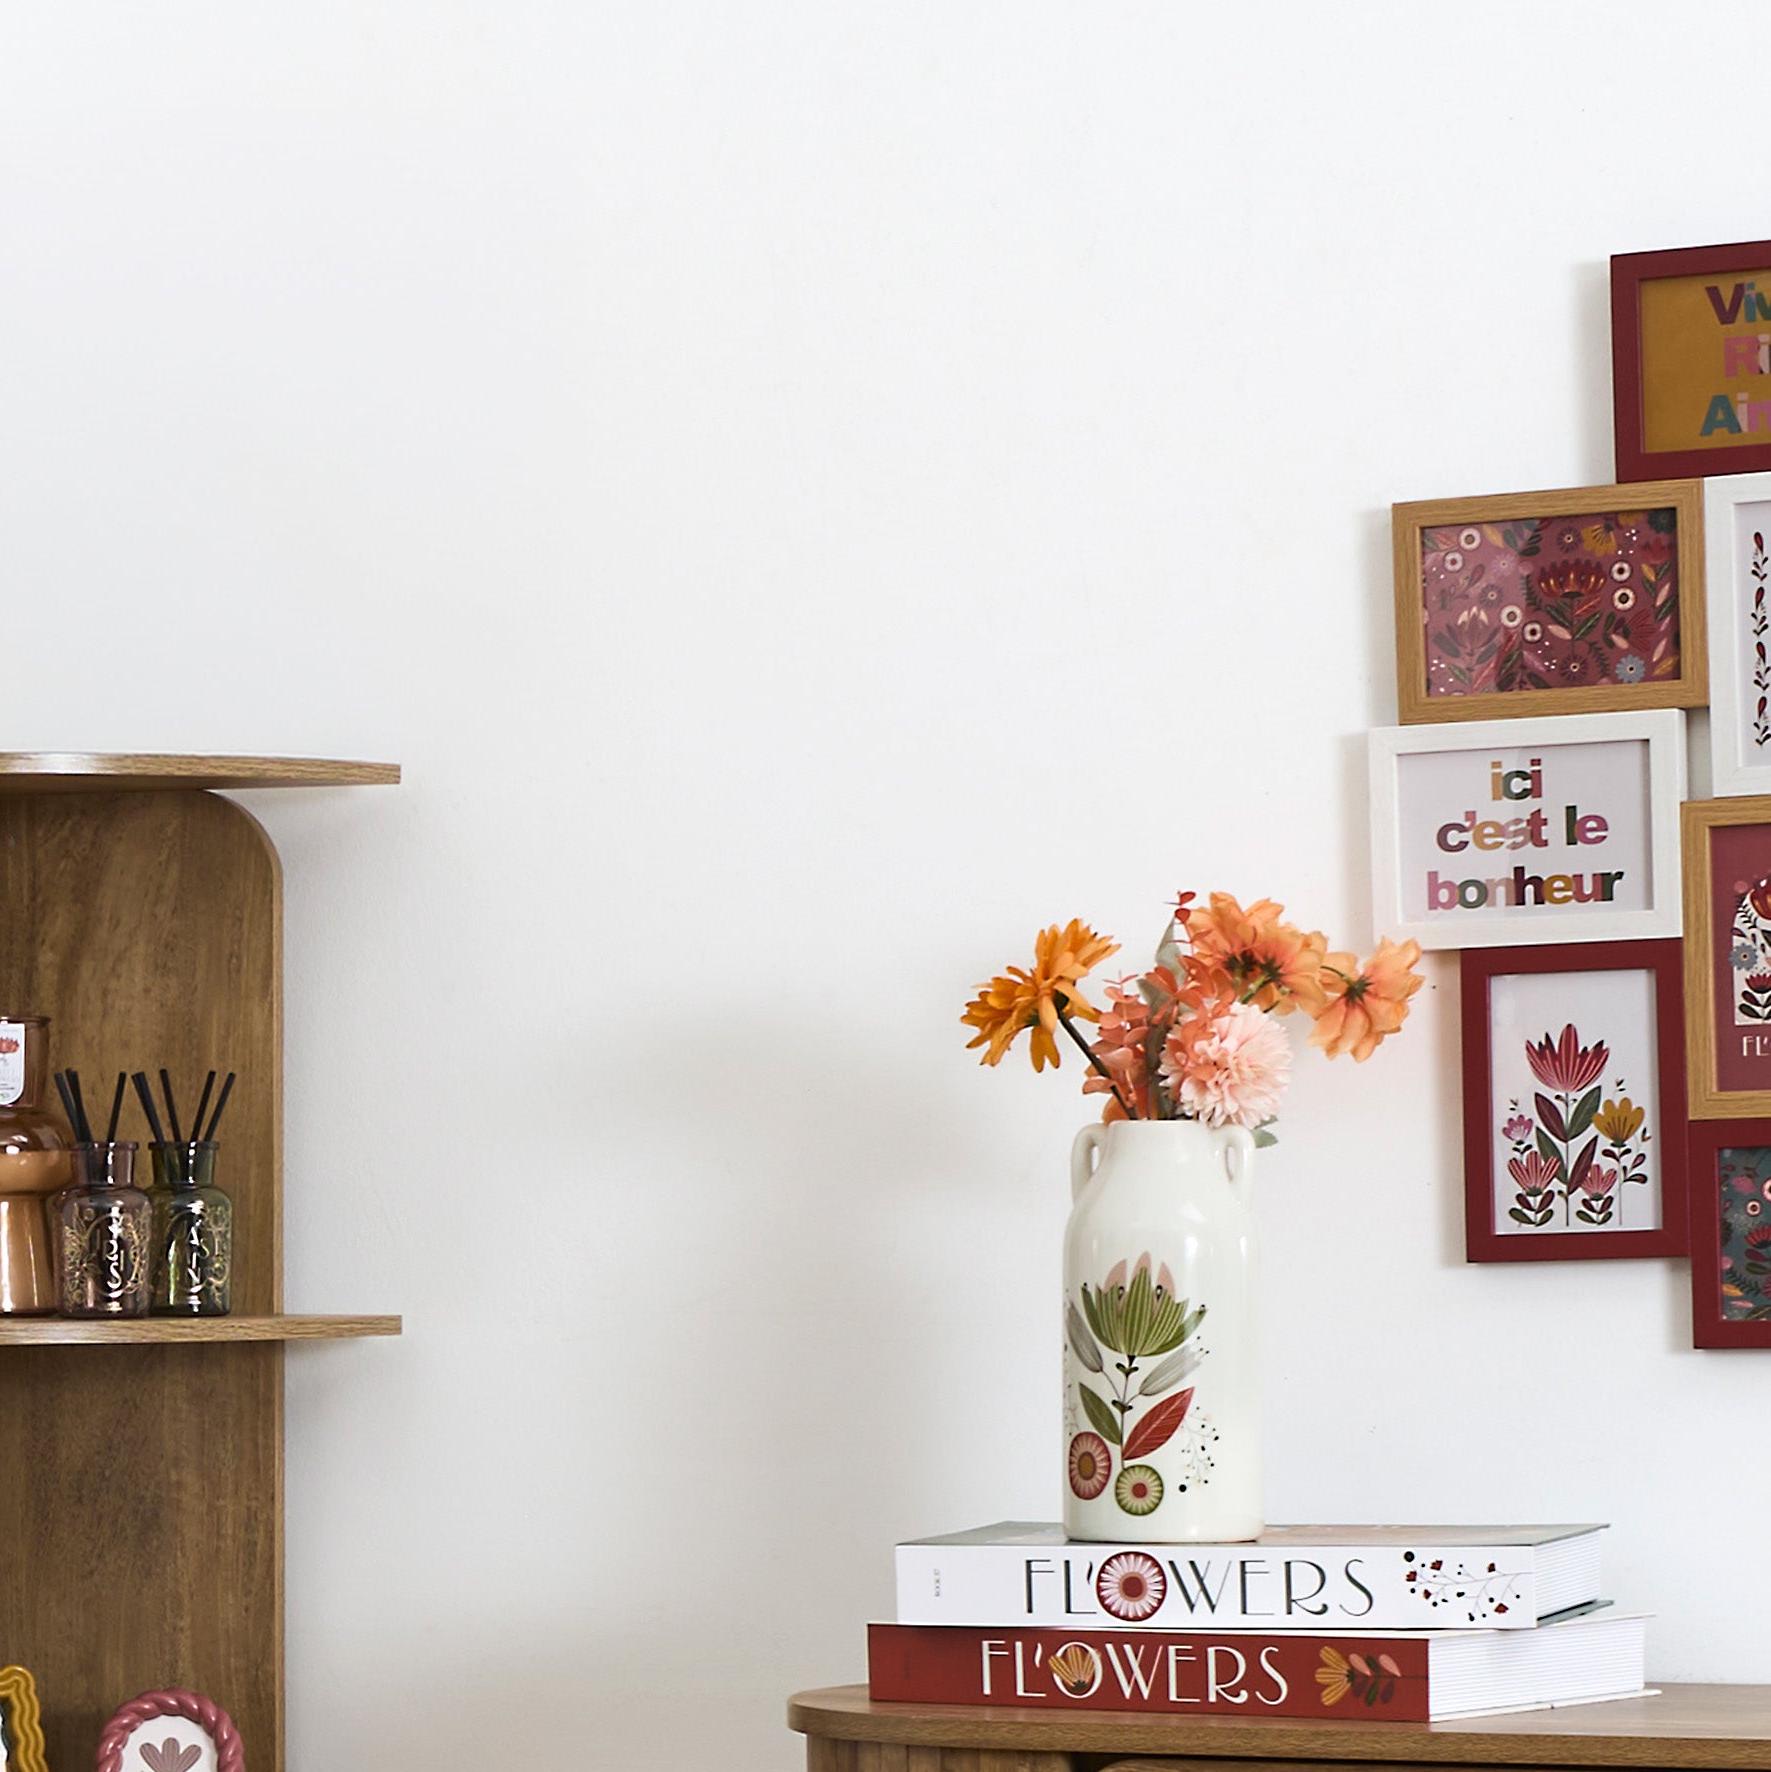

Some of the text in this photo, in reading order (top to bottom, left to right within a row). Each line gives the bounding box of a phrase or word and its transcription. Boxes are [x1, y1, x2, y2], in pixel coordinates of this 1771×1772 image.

[1723, 333, 1771, 379] Ri
[1491, 758, 1543, 801] ici
[1436, 805, 1609, 852] c'est le
[1427, 866, 1624, 910] bonheur
